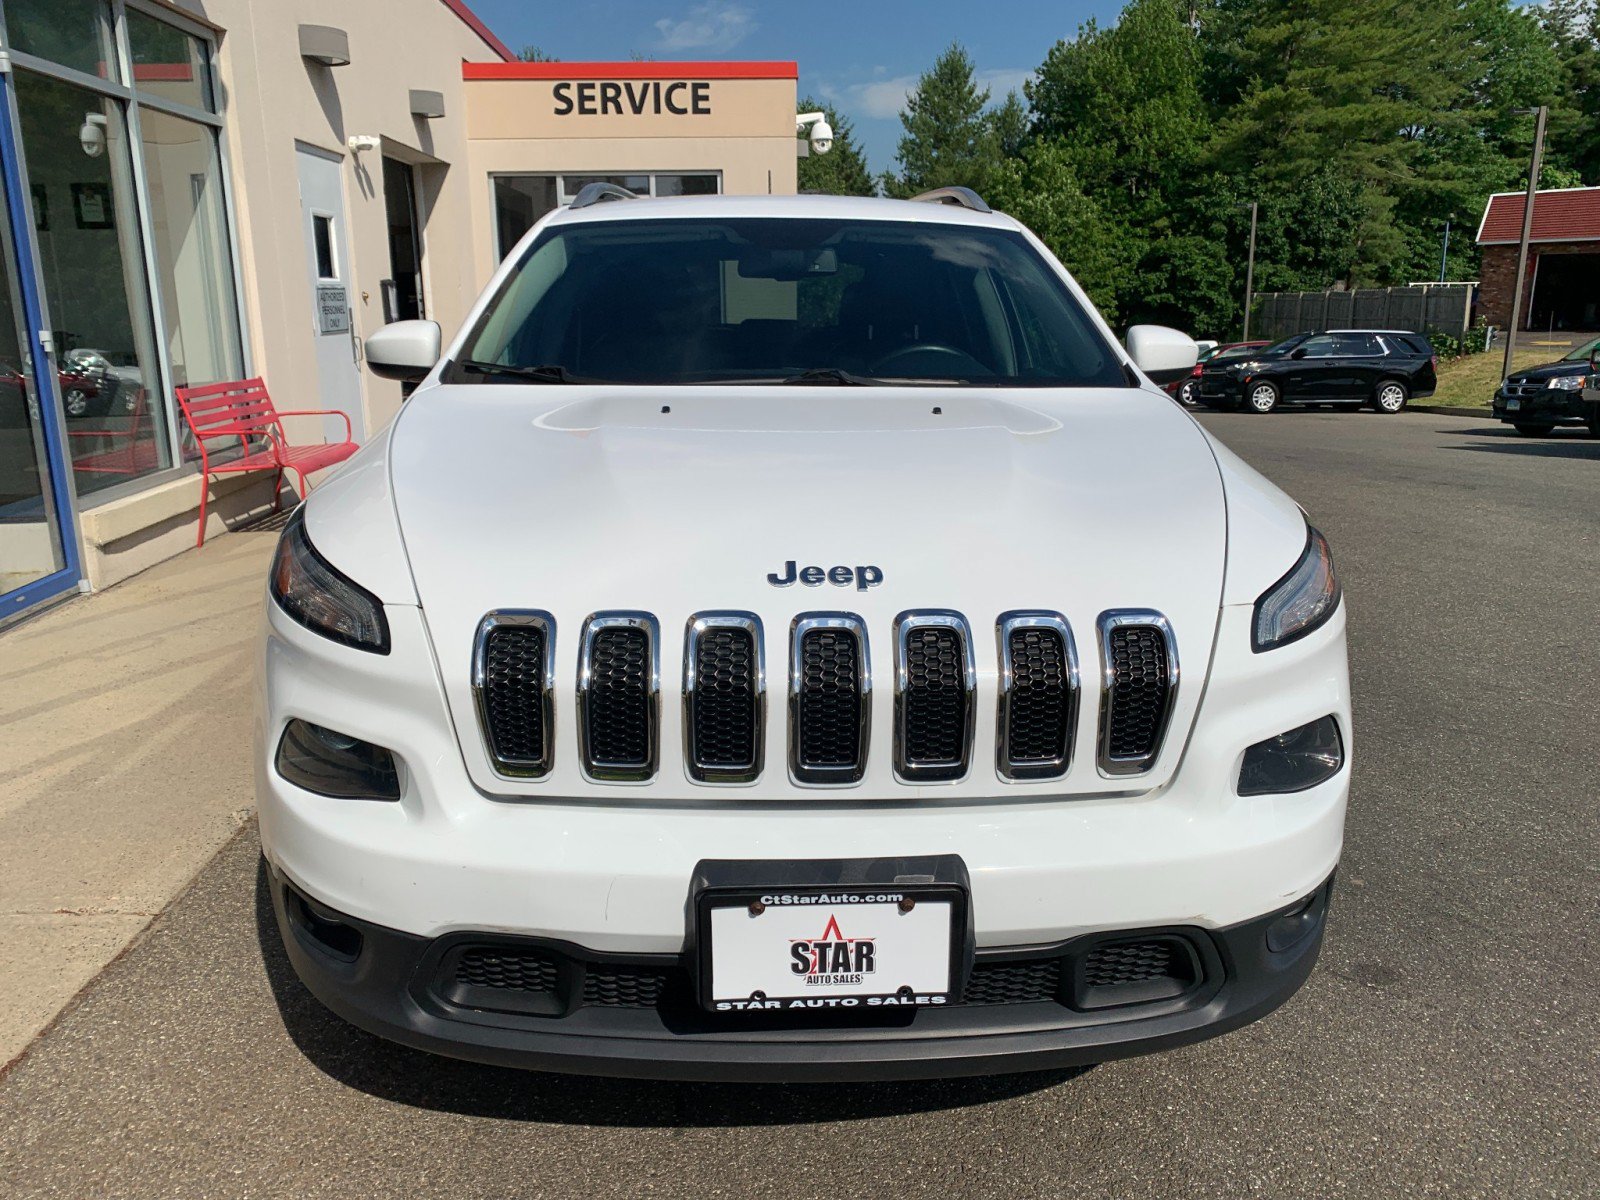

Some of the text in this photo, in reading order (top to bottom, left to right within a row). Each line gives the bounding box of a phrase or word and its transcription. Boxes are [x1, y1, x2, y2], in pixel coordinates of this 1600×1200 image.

[552, 82, 711, 115] SERVICE
[320, 292, 345, 302] AUTHORIZED
[321, 305, 346, 315] PERSONNEL
[329, 318, 340, 328] ONLY
[767, 560, 884, 592] Jeep
[760, 893, 904, 905] CtStarAuto.com
[791, 941, 875, 974] STAR
[806, 974, 862, 984] AUTO SALES
[716, 995, 947, 1011] STAR AUTO SALES
